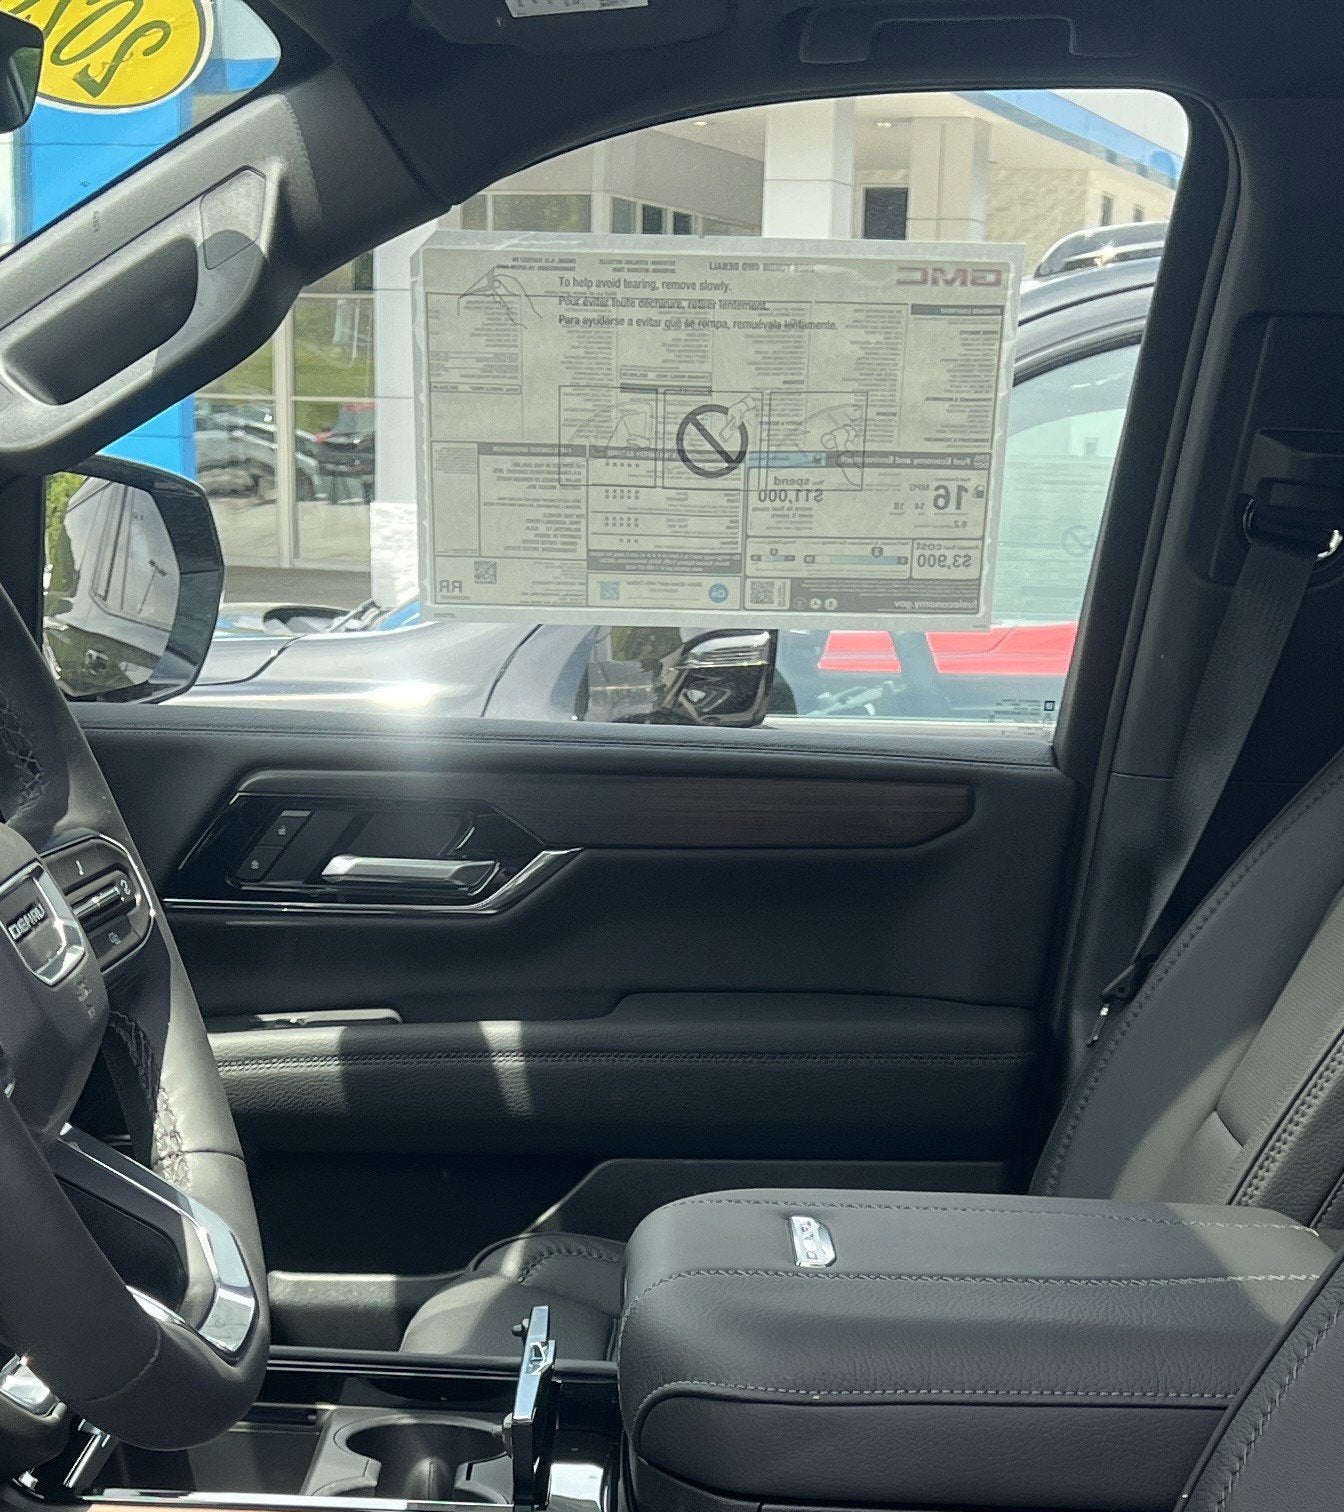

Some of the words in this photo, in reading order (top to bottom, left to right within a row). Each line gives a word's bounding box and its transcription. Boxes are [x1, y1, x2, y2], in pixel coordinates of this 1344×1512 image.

[558, 276, 570, 287] To
[573, 277, 594, 290] help
[595, 277, 621, 289] avoid
[623, 278, 659, 291] tearing,
[661, 281, 697, 290] remove
[699, 280, 732, 293] slowly.
[558, 296, 580, 306] Pour
[558, 314, 580, 325] Para
[582, 315, 625, 328] ayudarse
[636, 316, 661, 328] evitar
[697, 319, 730, 330] rompa,
[784, 320, 838, 331] lentamente.
[8, 902, 45, 940] DENALI
